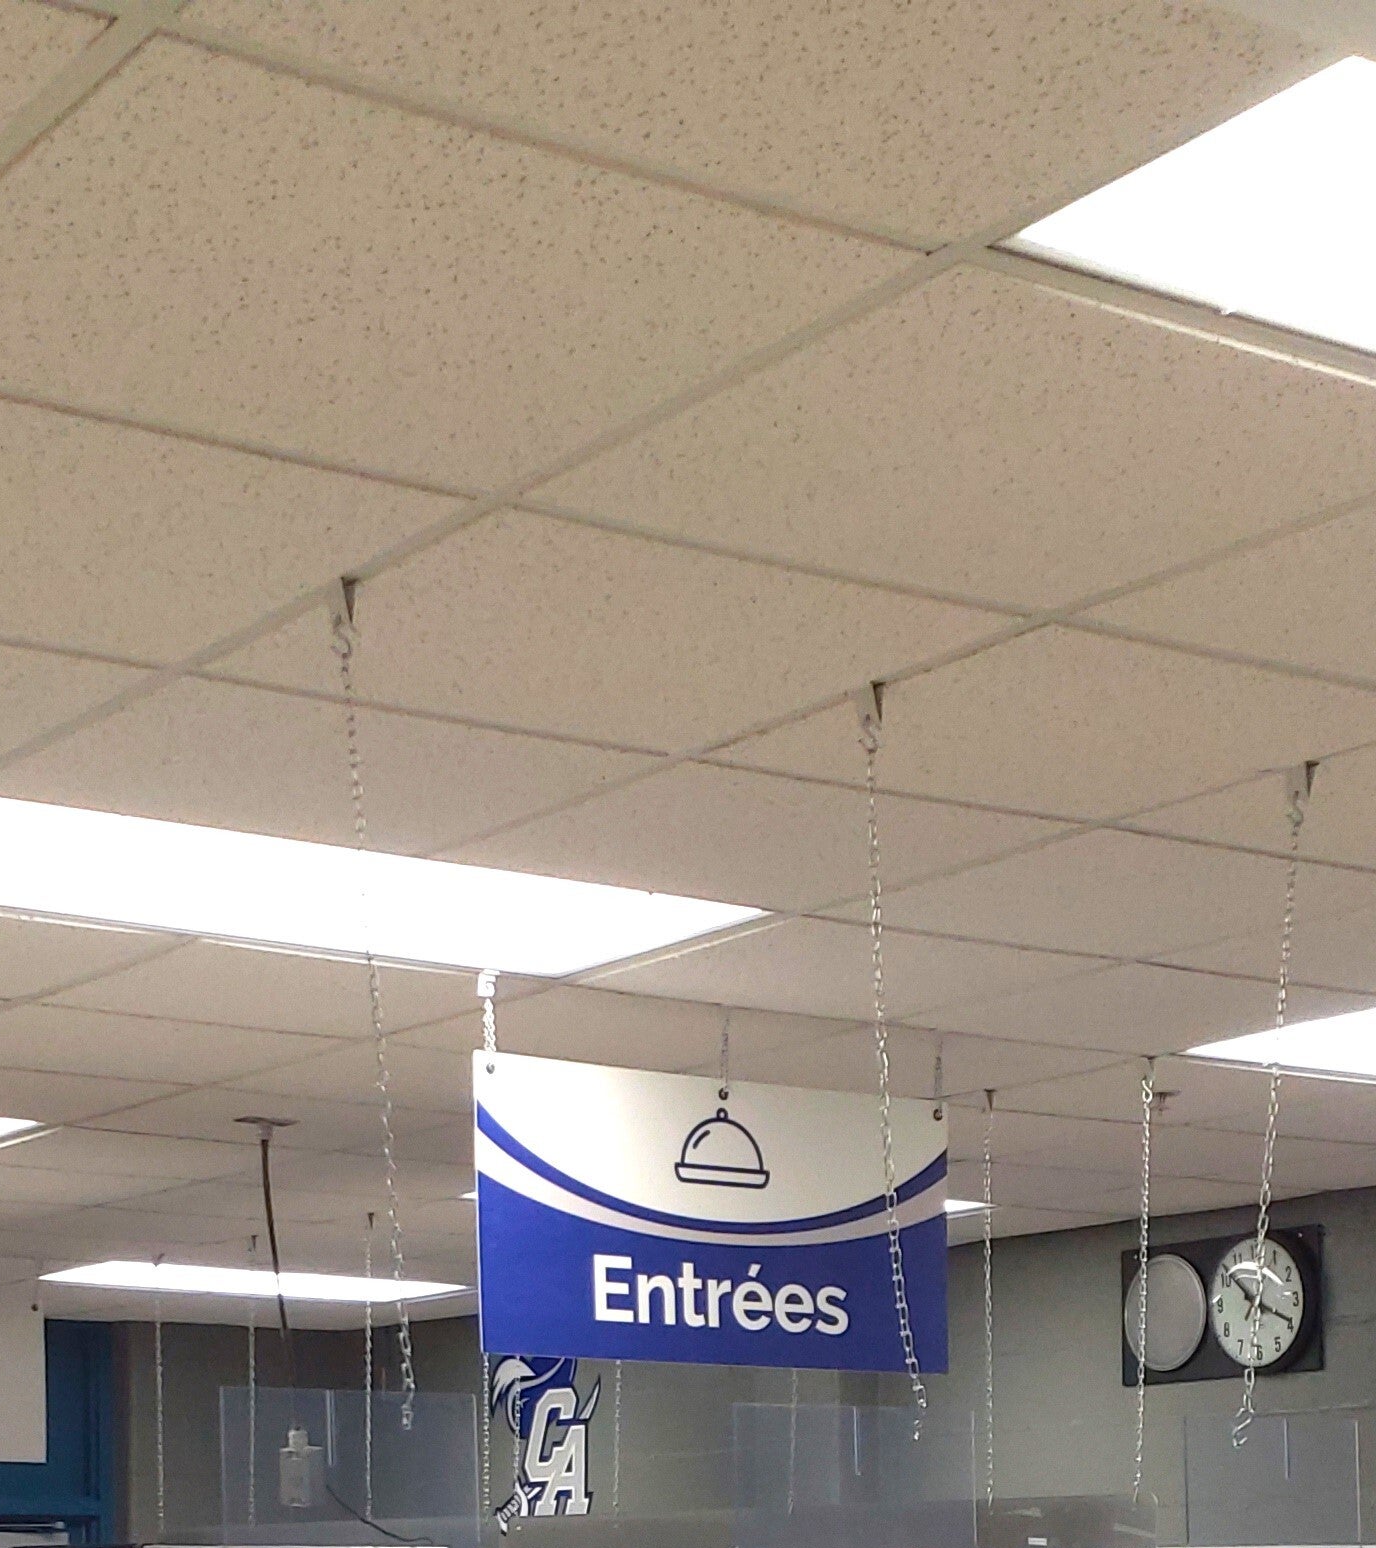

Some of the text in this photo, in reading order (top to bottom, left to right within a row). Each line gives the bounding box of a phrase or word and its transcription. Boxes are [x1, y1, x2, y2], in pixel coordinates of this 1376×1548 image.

[1285, 1265, 1292, 1283] 2
[591, 1253, 850, 1335] Entrées
[1292, 1291, 1299, 1307] 3
[1217, 1297, 1224, 1314] 9
[1223, 1321, 1230, 1338] 8
[1287, 1318, 1294, 1333] 4
[1237, 1339, 1244, 1356] 7
[1274, 1336, 1281, 1353] 5
[522, 1386, 594, 1517] CA
